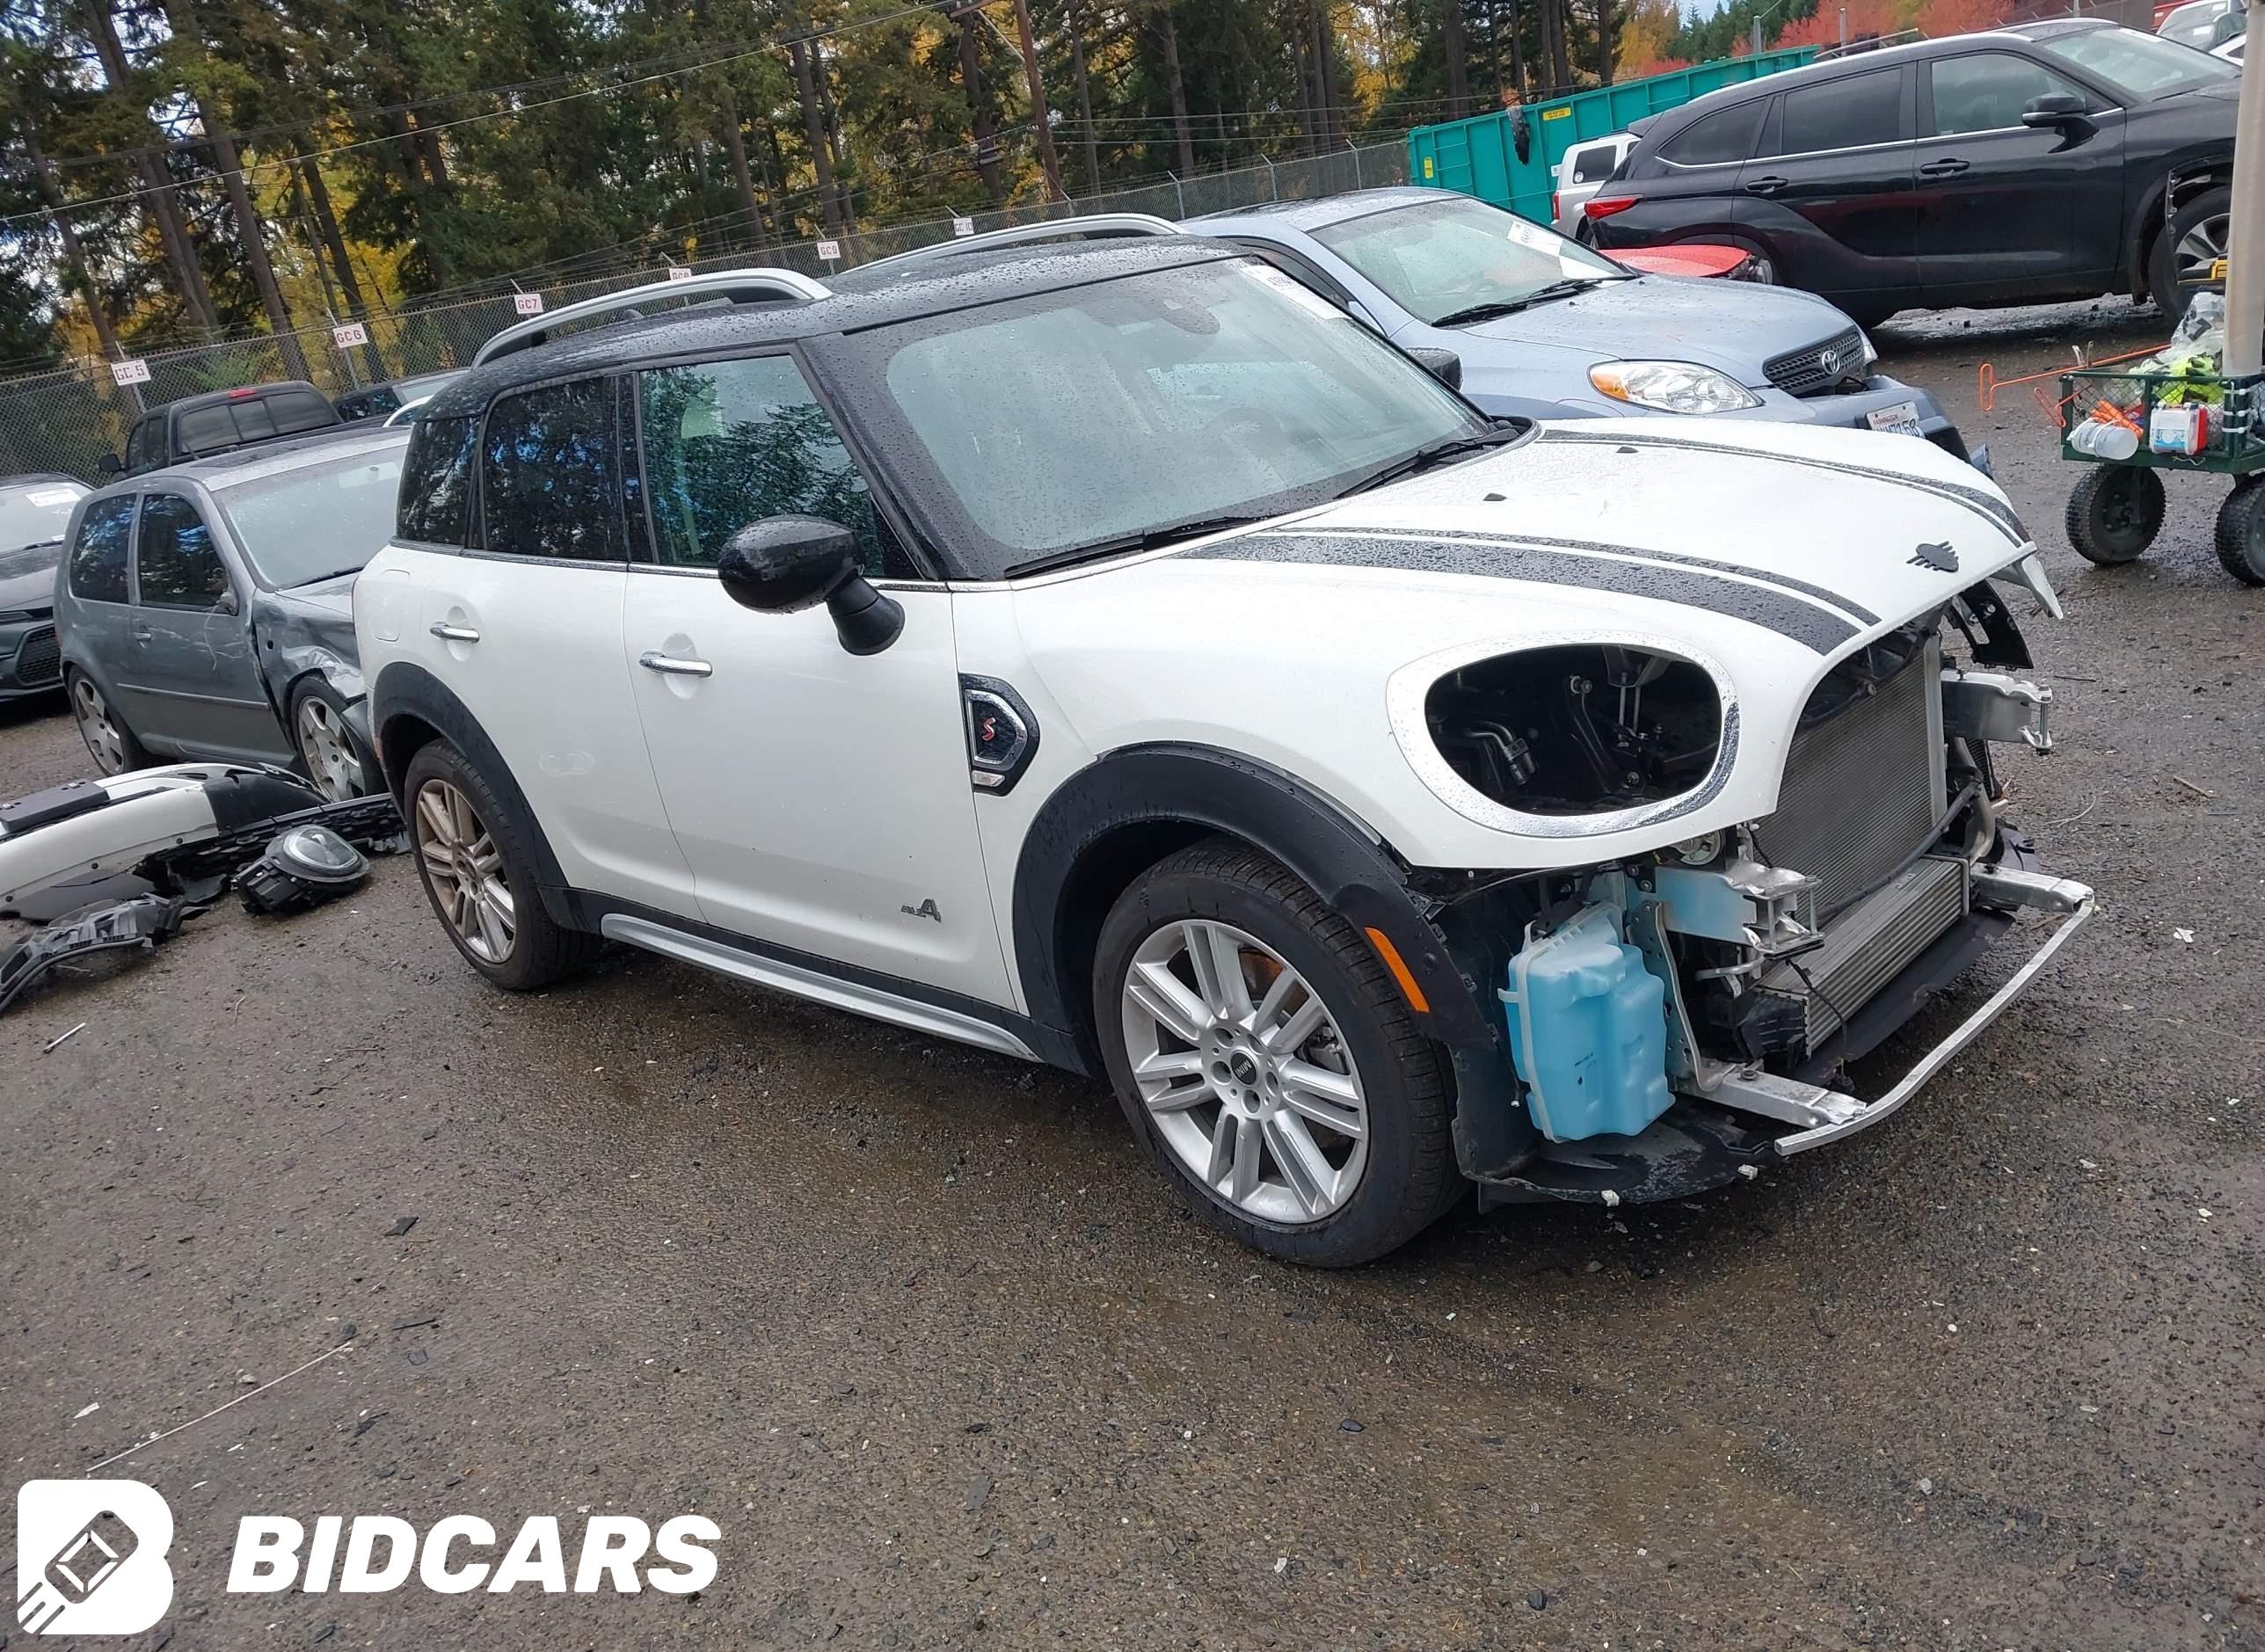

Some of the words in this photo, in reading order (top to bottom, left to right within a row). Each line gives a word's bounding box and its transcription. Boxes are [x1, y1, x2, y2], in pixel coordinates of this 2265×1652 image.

[518, 298, 537, 309] GC7
[981, 717, 996, 741] S
[1234, 1059, 1252, 1079] MINI
